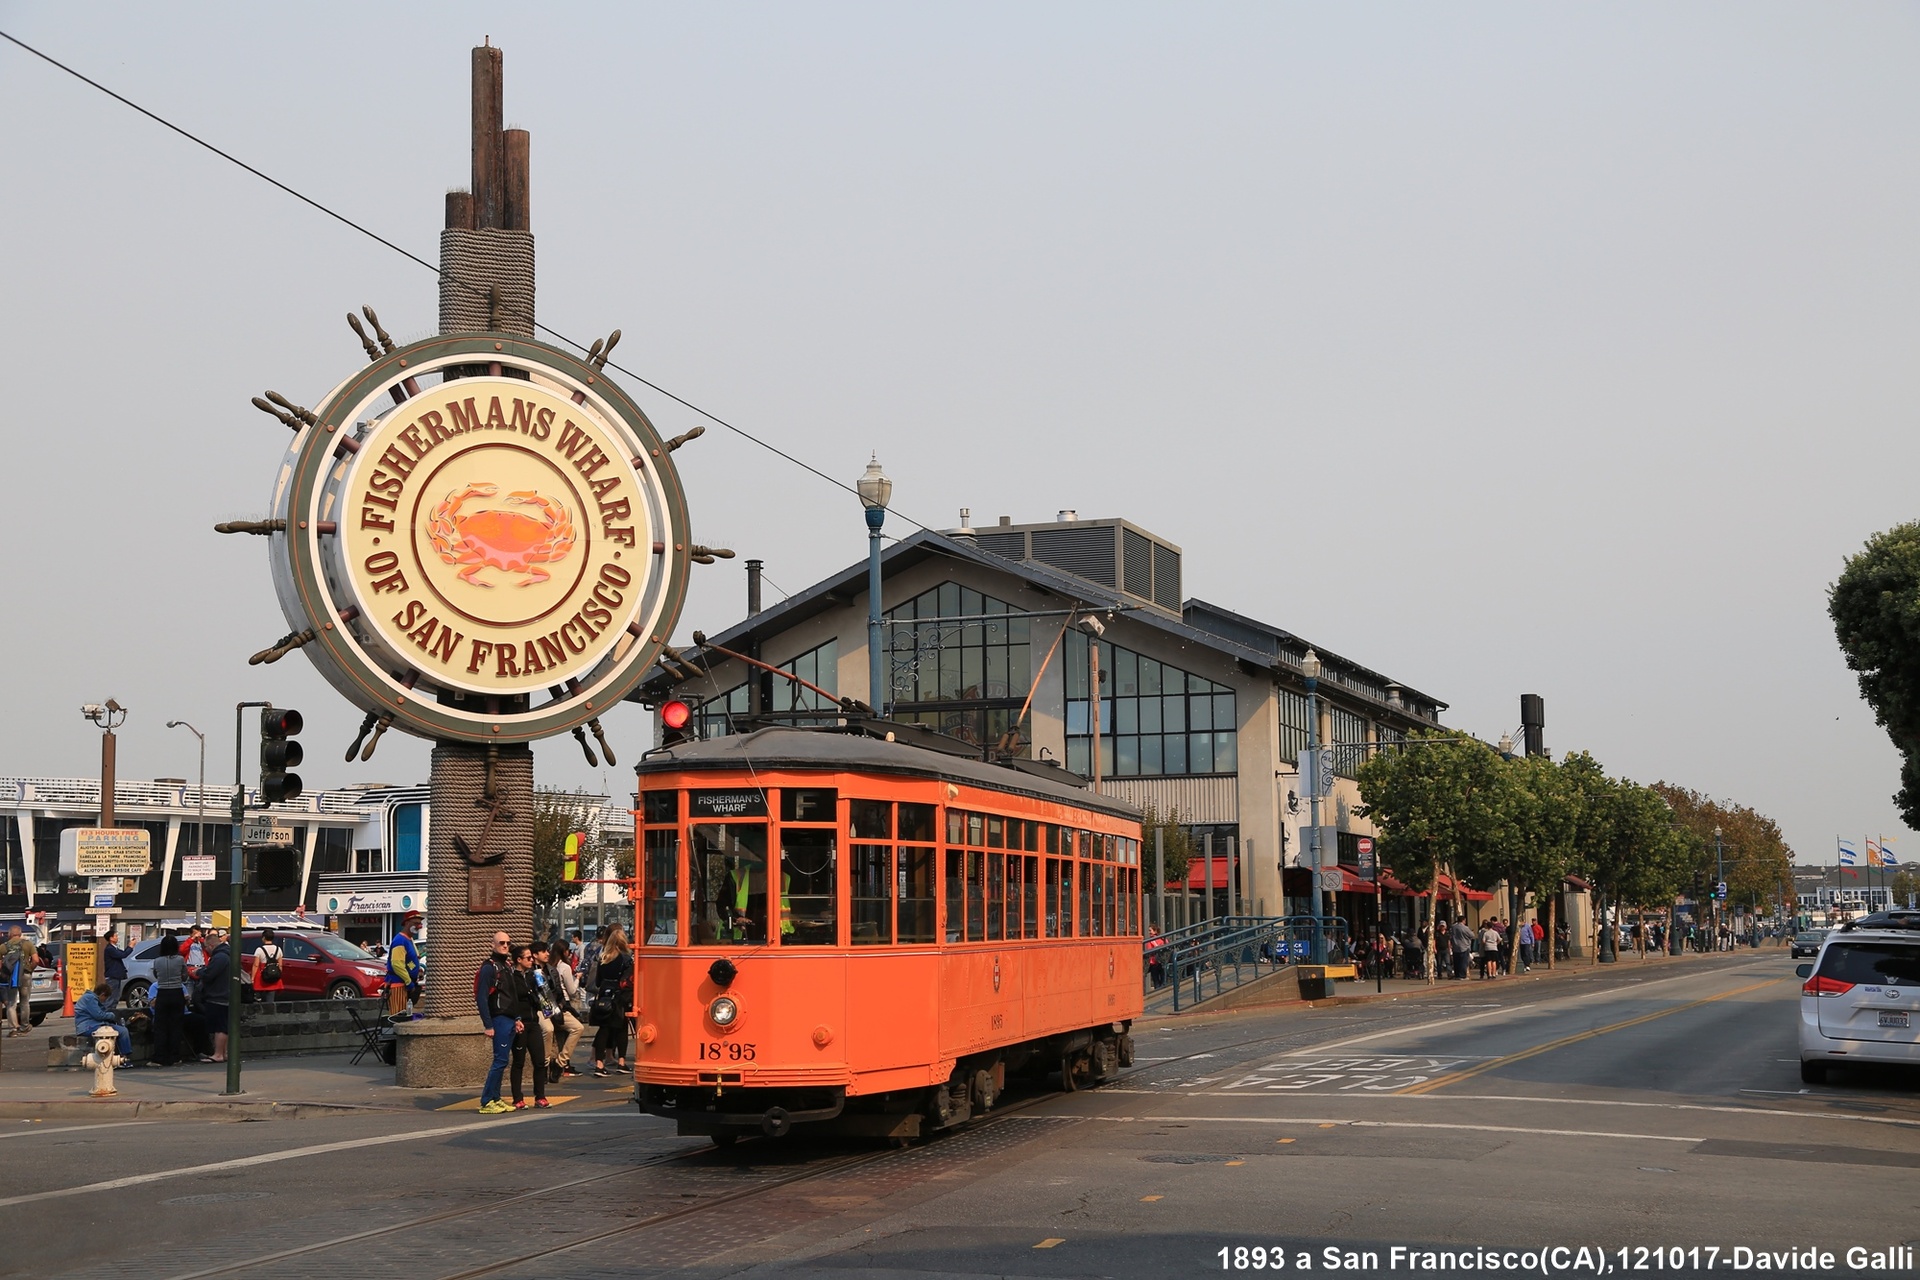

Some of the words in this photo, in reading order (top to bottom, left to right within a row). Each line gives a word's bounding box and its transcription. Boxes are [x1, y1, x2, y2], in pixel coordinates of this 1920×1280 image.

[361, 396, 557, 533] FISHERMANS
[554, 419, 636, 548] WHARF
[364, 550, 410, 595] OF
[391, 599, 465, 665] SAN
[467, 563, 633, 677] FRANCISCO
[698, 794, 761, 804] FISHERMAN'S
[712, 804, 746, 812] WHARF
[796, 792, 816, 819] F
[248, 829, 290, 840] Jefferson
[343, 895, 392, 914] Franciscan
[699, 1042, 756, 1061] 1895
[1255, 1058, 1471, 1072] KEEP
